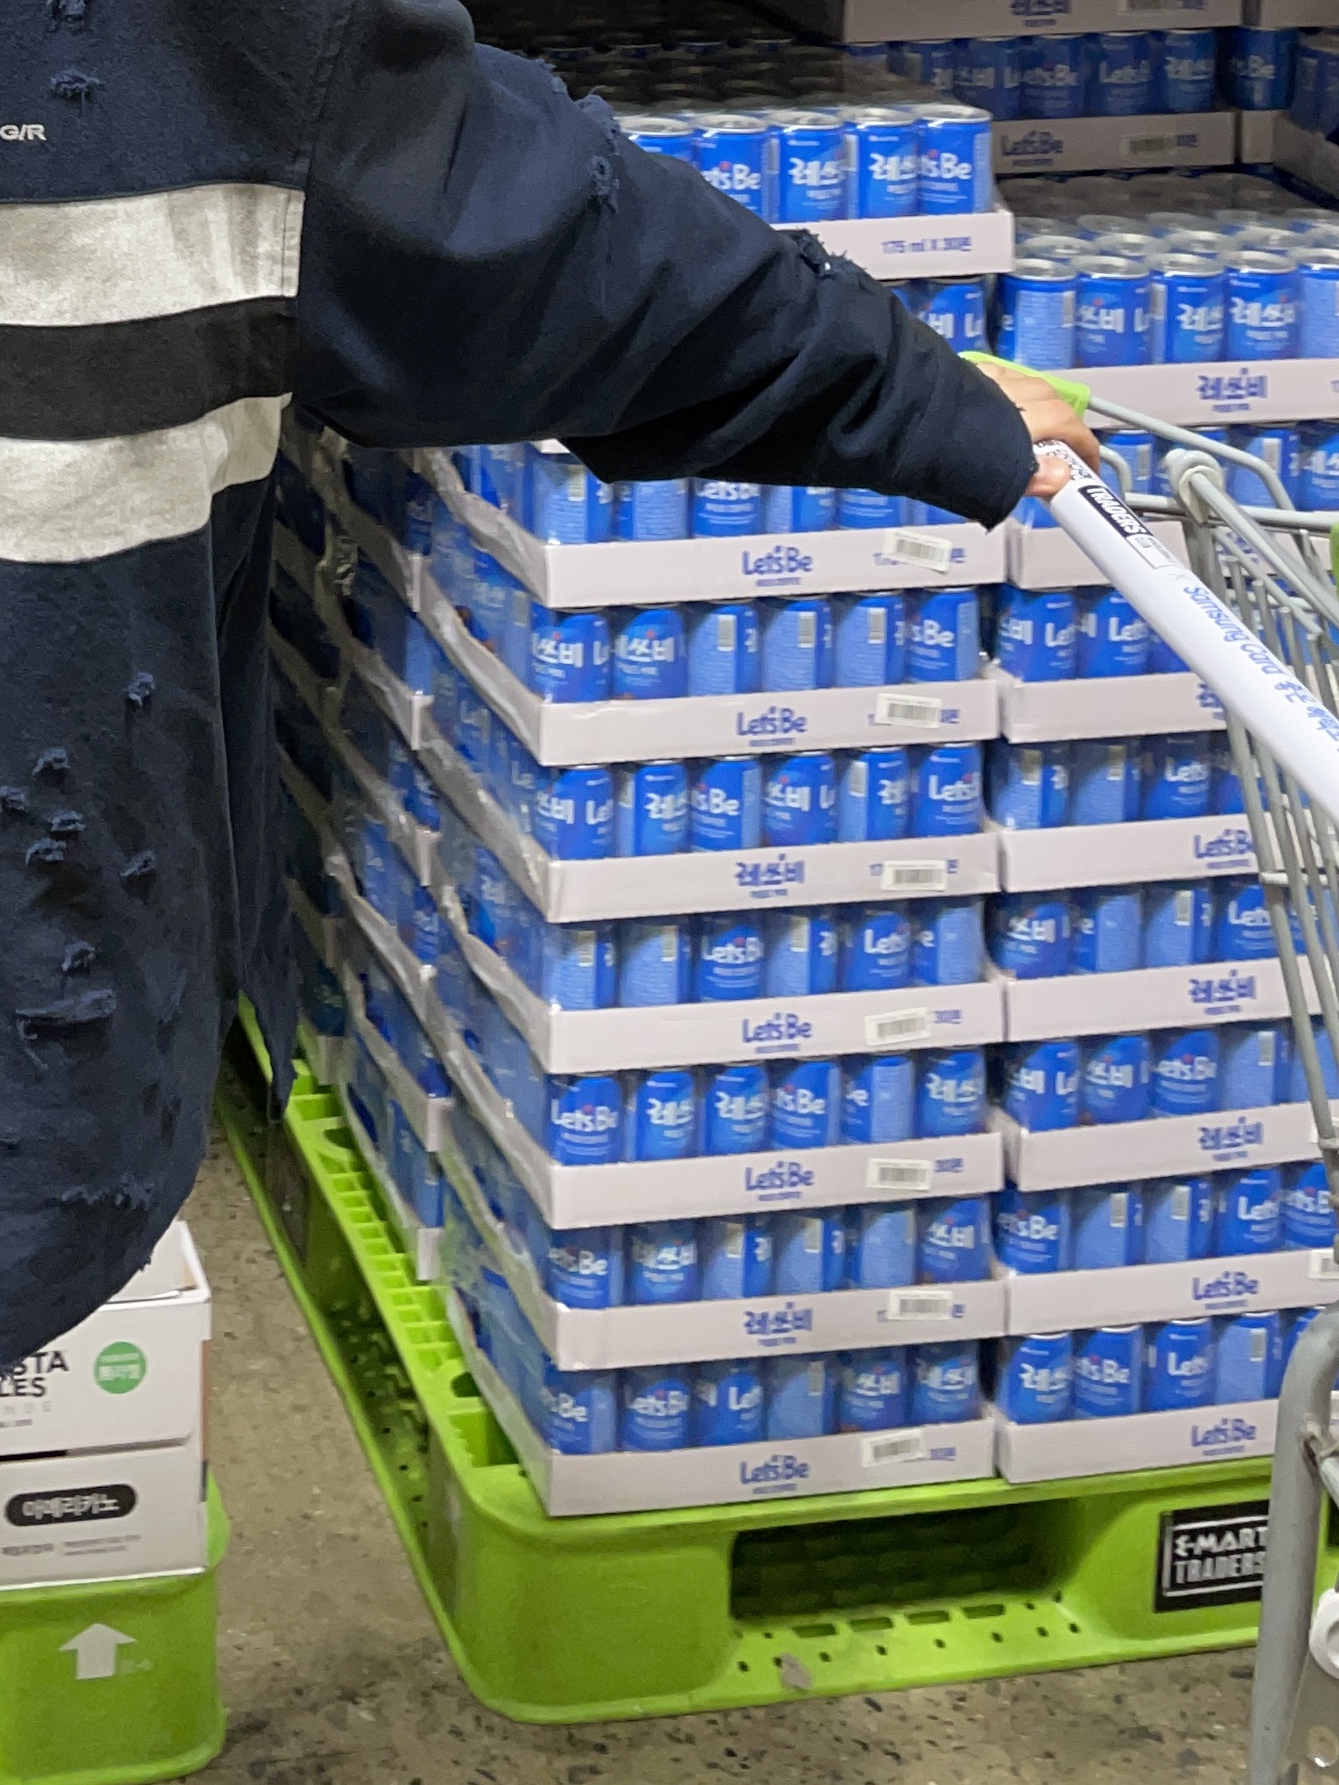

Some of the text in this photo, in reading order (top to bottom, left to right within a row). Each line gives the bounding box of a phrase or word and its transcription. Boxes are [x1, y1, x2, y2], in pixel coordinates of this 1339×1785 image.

[1197, 366, 1268, 400] 레쓰비
[1085, 485, 1147, 536] TRADERS
[1183, 585, 1285, 675] Samsung Card
[734, 852, 806, 888] 레쓰비
[1188, 970, 1257, 1003] 레쓰비
[1198, 1116, 1264, 1151] 레쓰비
[744, 1301, 813, 1336] 레쓰비
